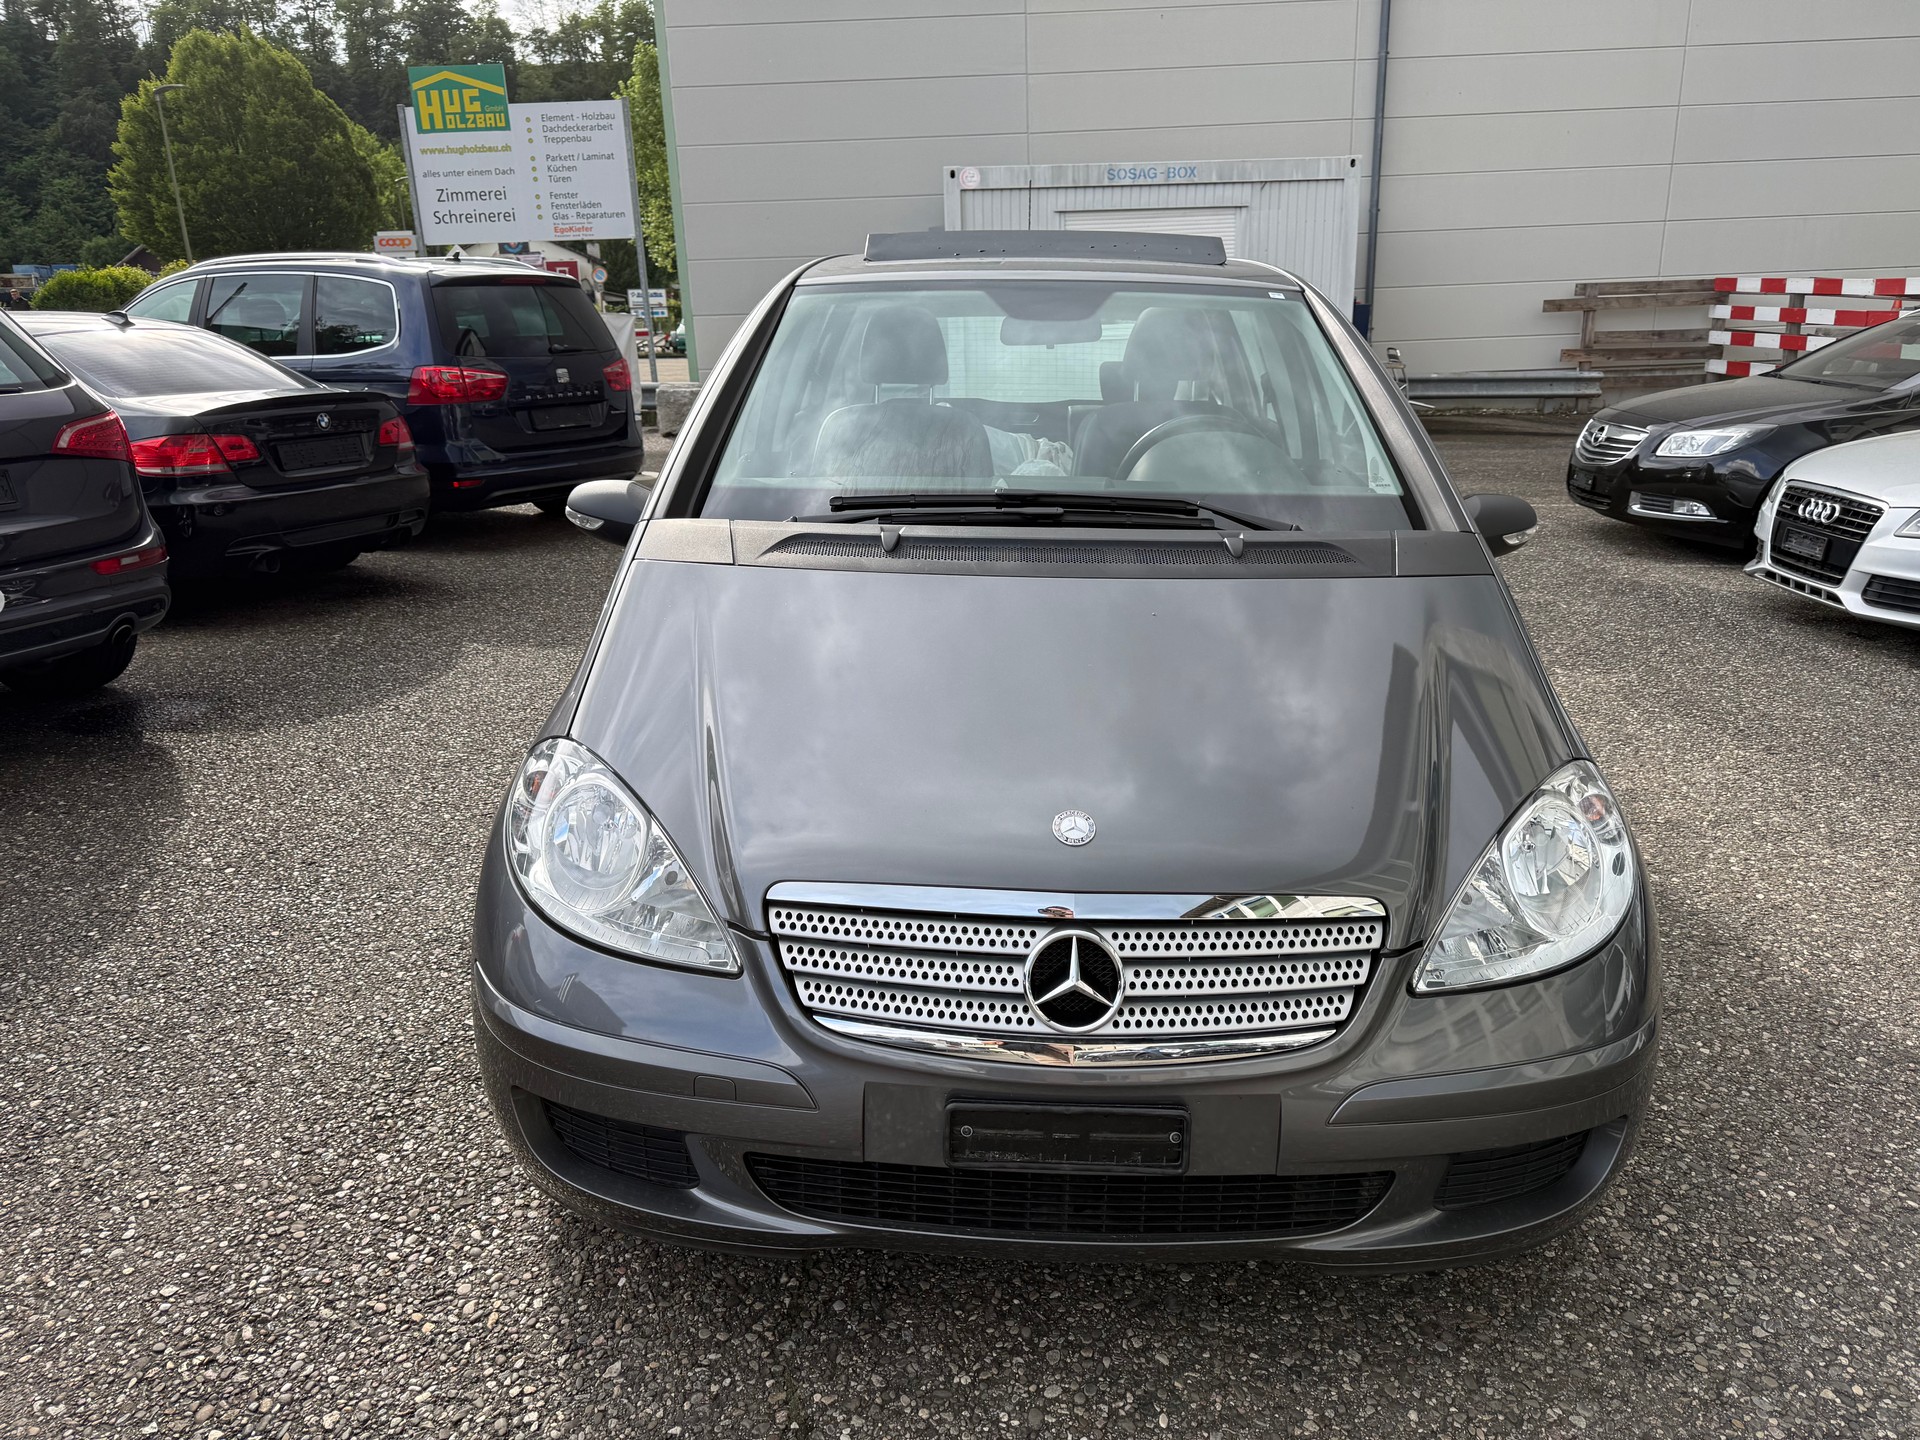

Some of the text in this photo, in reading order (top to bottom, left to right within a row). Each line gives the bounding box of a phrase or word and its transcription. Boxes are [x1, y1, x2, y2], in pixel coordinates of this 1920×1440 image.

[541, 113, 575, 122] Element
[581, 111, 616, 121] Holzbau
[542, 122, 614, 133] Dachdeckerarbeit
[543, 134, 592, 144] Treppenbau
[420, 143, 512, 156] www.hugholzbau.ch
[545, 153, 576, 162] Parkett
[582, 151, 615, 161] Laminat
[422, 166, 515, 178] alles unter einem Dach
[547, 164, 577, 173] Küchen
[548, 174, 572, 183] Türen
[436, 186, 507, 203] Zimmerei
[549, 191, 578, 200] Fenster
[551, 200, 602, 210] Fensterläden
[433, 207, 516, 225] Schreinerei
[552, 212, 569, 221] Glas
[576, 211, 626, 221] Reparaturen
[554, 225, 593, 234] EgoKiefer
[379, 238, 412, 248] coop
